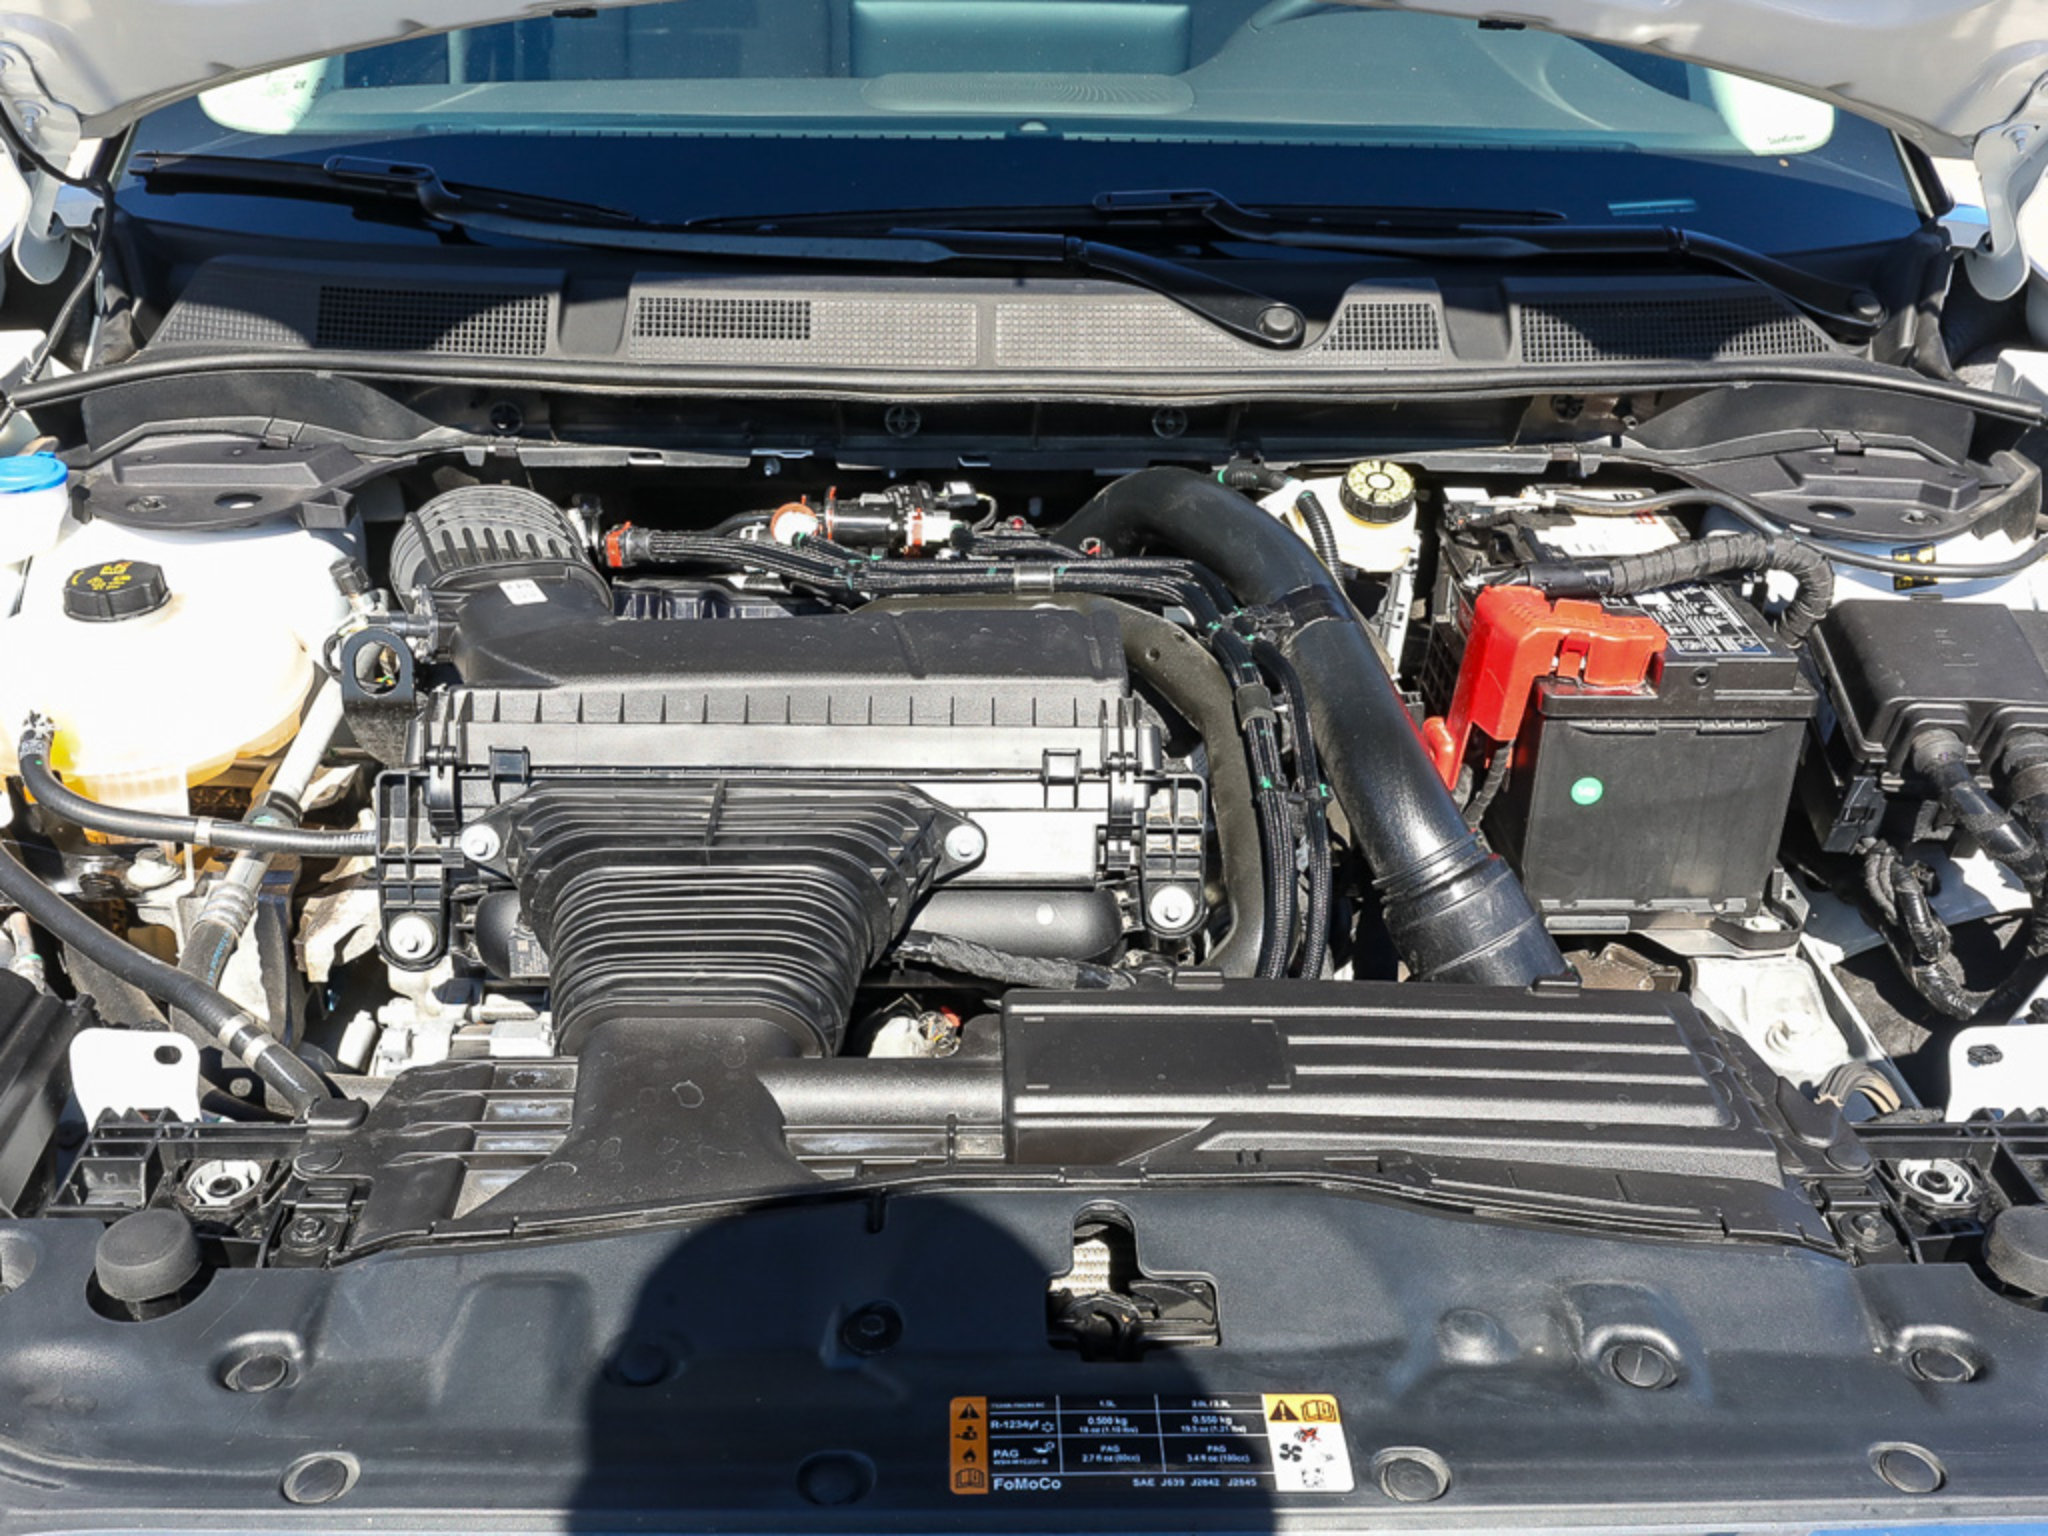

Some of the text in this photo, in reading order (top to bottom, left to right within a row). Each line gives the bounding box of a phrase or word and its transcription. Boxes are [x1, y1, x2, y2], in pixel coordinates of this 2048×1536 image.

[990, 1419, 1039, 1431] R-1234yf
[1087, 1416, 1128, 1427] 0.500 kg
[1191, 1415, 1233, 1426] 0.550 kg
[993, 1449, 1019, 1459] PAG
[1100, 1445, 1120, 1453] PAG
[1206, 1445, 1227, 1453] PAG
[993, 1477, 1062, 1491] FoMoCo
[1132, 1478, 1155, 1487] SAE
[1161, 1478, 1185, 1487] J639
[1227, 1478, 1258, 1487] J2845
